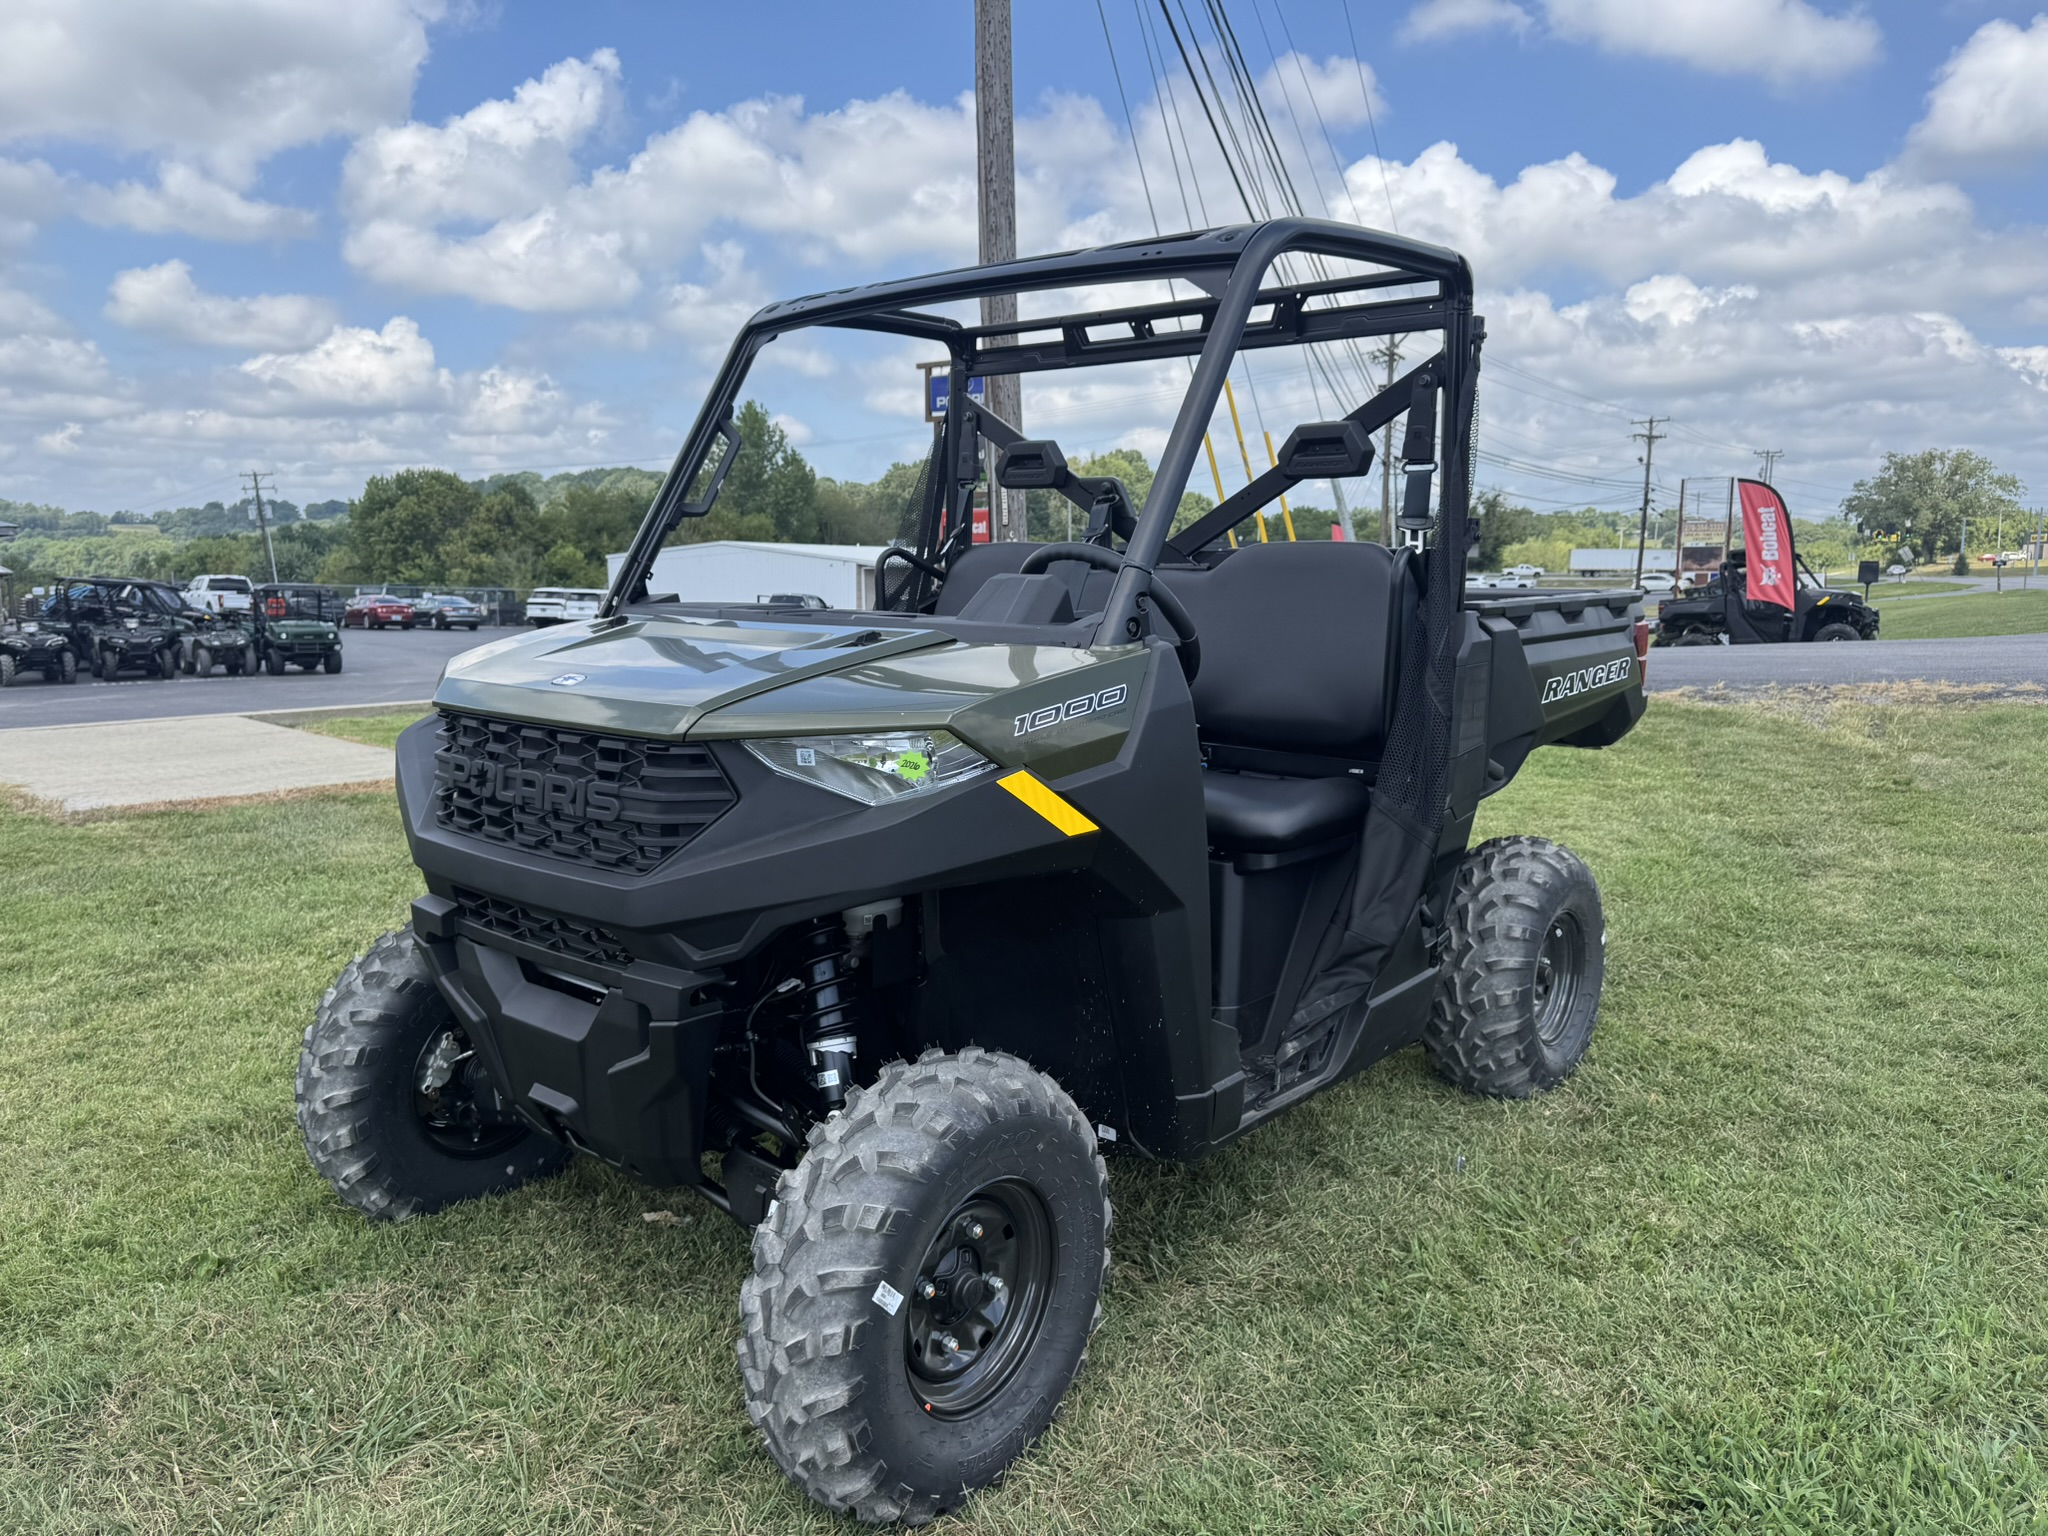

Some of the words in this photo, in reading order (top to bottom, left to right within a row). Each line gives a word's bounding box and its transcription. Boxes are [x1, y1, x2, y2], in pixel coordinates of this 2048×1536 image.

[972, 520, 987, 534] cat
[1757, 507, 1779, 561] Bobcat
[1541, 657, 1631, 704] RANGER
[1014, 684, 1127, 736] 1000
[449, 753, 621, 822] POLARIS
[901, 759, 921, 770] 2026
